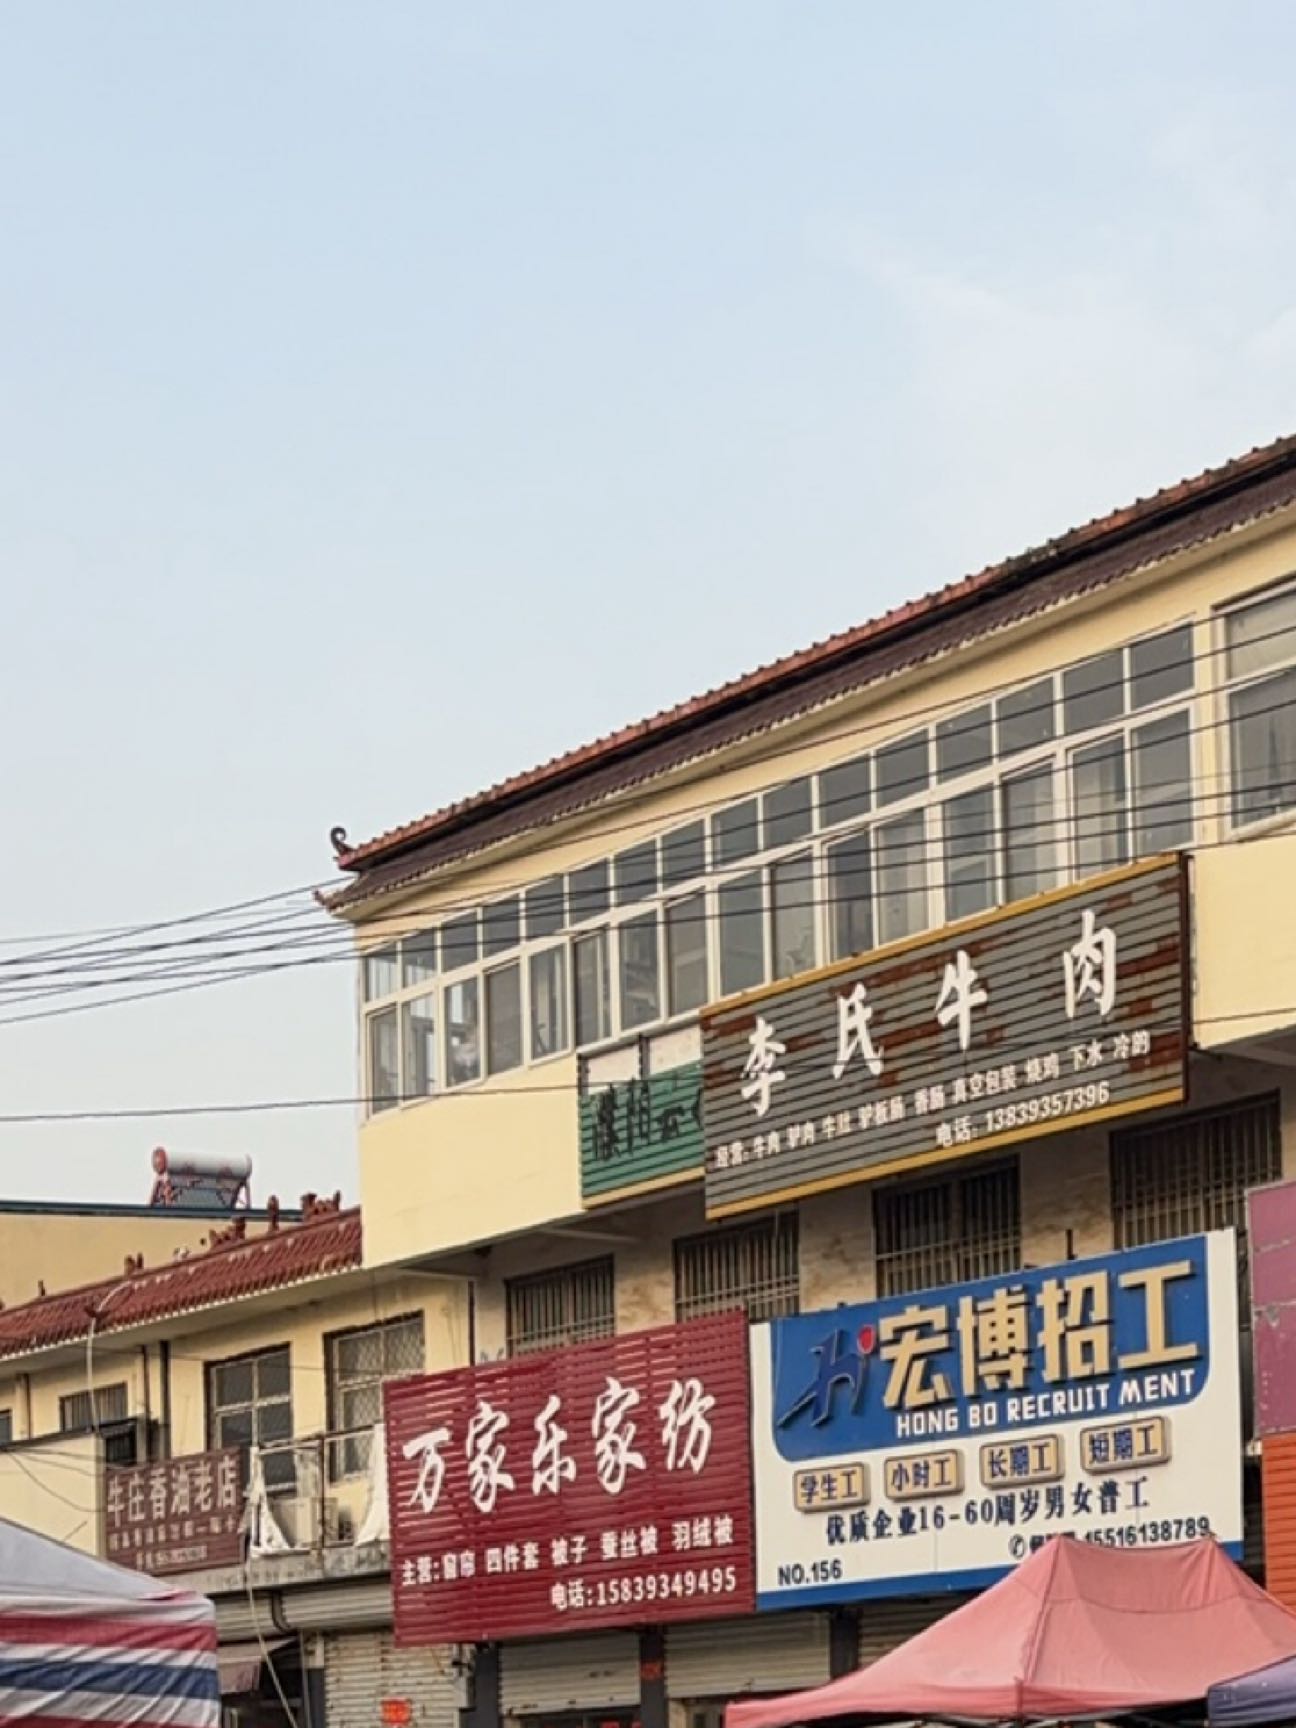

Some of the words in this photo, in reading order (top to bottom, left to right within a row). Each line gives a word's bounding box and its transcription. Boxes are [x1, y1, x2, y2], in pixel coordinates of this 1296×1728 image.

[739, 908, 1118, 1118] 李氏牛肉
[1069, 1039, 1102, 1071] 下水
[878, 1260, 1200, 1409] 宏博招工
[896, 1411, 959, 1439] HONG
[1007, 1384, 1110, 1423] RECRUIT
[1119, 1369, 1197, 1406] MENT
[402, 1376, 717, 1514] 万家乐家纺
[988, 1444, 1051, 1478] 长期工
[1088, 1423, 1160, 1463] 短期工
[800, 1470, 858, 1505] 学生工
[891, 1459, 953, 1492] 小时工
[486, 1541, 541, 1574] 四件套
[551, 1535, 588, 1567] 被子
[671, 1514, 735, 1550] 羽绒被
[778, 1559, 843, 1586] NO.156
